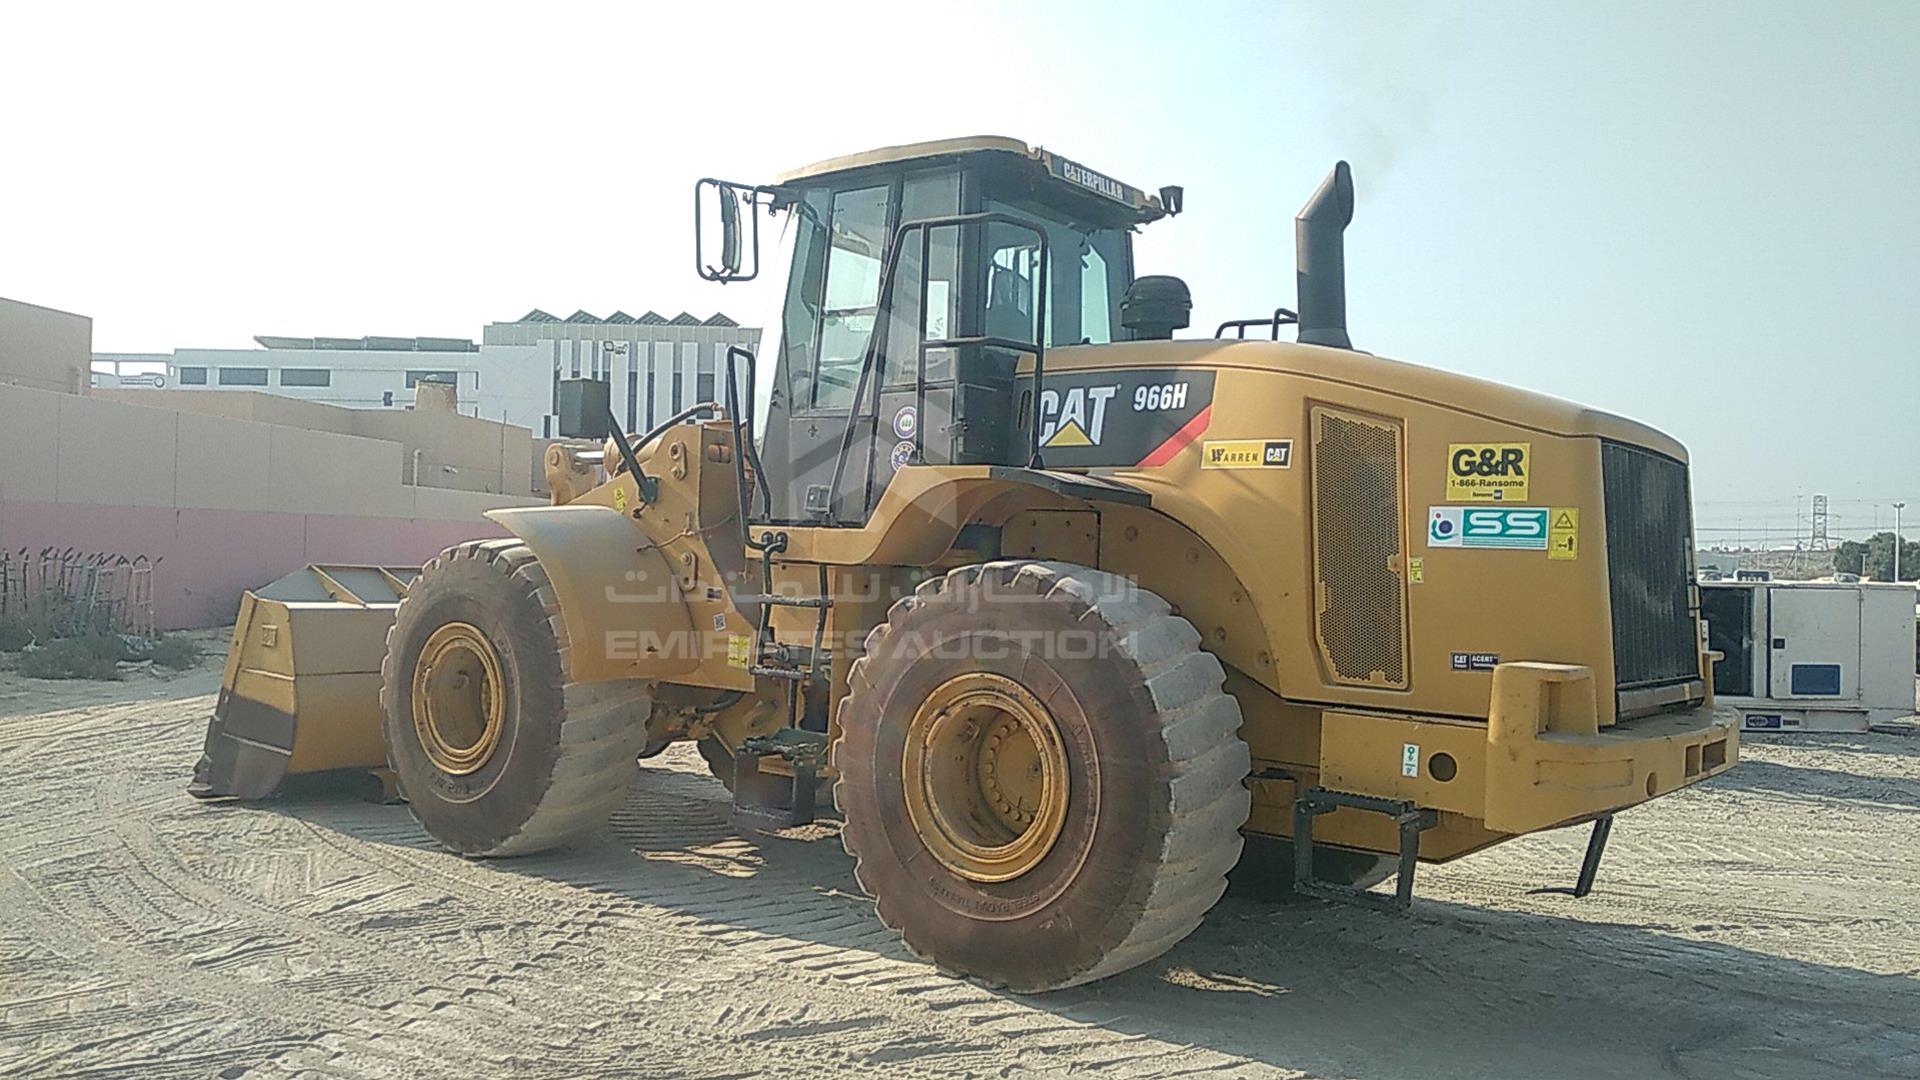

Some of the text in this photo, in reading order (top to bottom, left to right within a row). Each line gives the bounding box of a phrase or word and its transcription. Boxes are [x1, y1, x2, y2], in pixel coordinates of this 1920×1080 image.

[1063, 162, 1123, 200] CATERPILLAR
[1133, 382, 1188, 411] 966H
[1039, 384, 1115, 447] CAT
[1211, 448, 1258, 463] WARREN
[1266, 447, 1287, 462] CAT
[1452, 448, 1524, 477] G&R
[1451, 479, 1524, 488] 1-866-Ransome
[1469, 512, 1542, 535] SS
